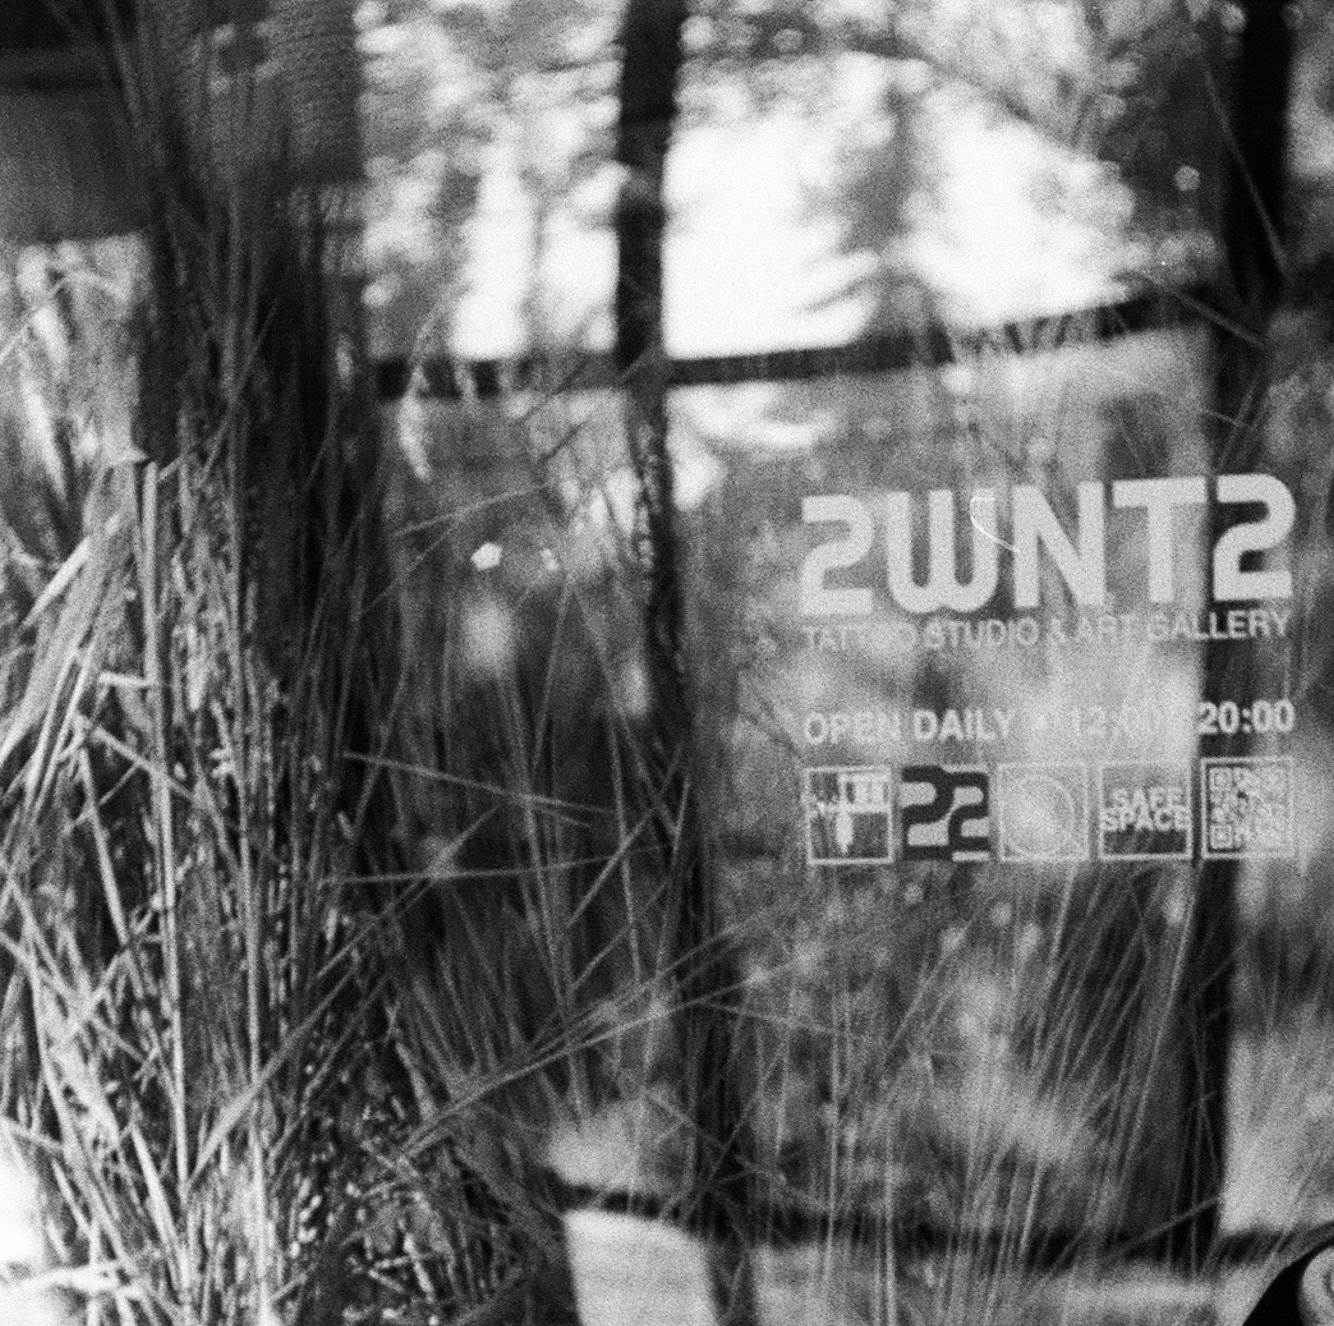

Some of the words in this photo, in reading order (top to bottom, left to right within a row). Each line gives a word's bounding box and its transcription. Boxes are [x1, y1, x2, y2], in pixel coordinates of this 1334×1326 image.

[801, 473, 1297, 616] 2WNT2
[922, 616, 1039, 649] STUDIO
[1074, 612, 1137, 643] ART
[1146, 608, 1293, 642] GALLERY
[803, 710, 901, 745] OPEN
[914, 707, 1014, 742] DAILY
[1197, 698, 1296, 735] 20:00
[1100, 804, 1192, 833] SPACE
[1111, 786, 1183, 810] SAFE
